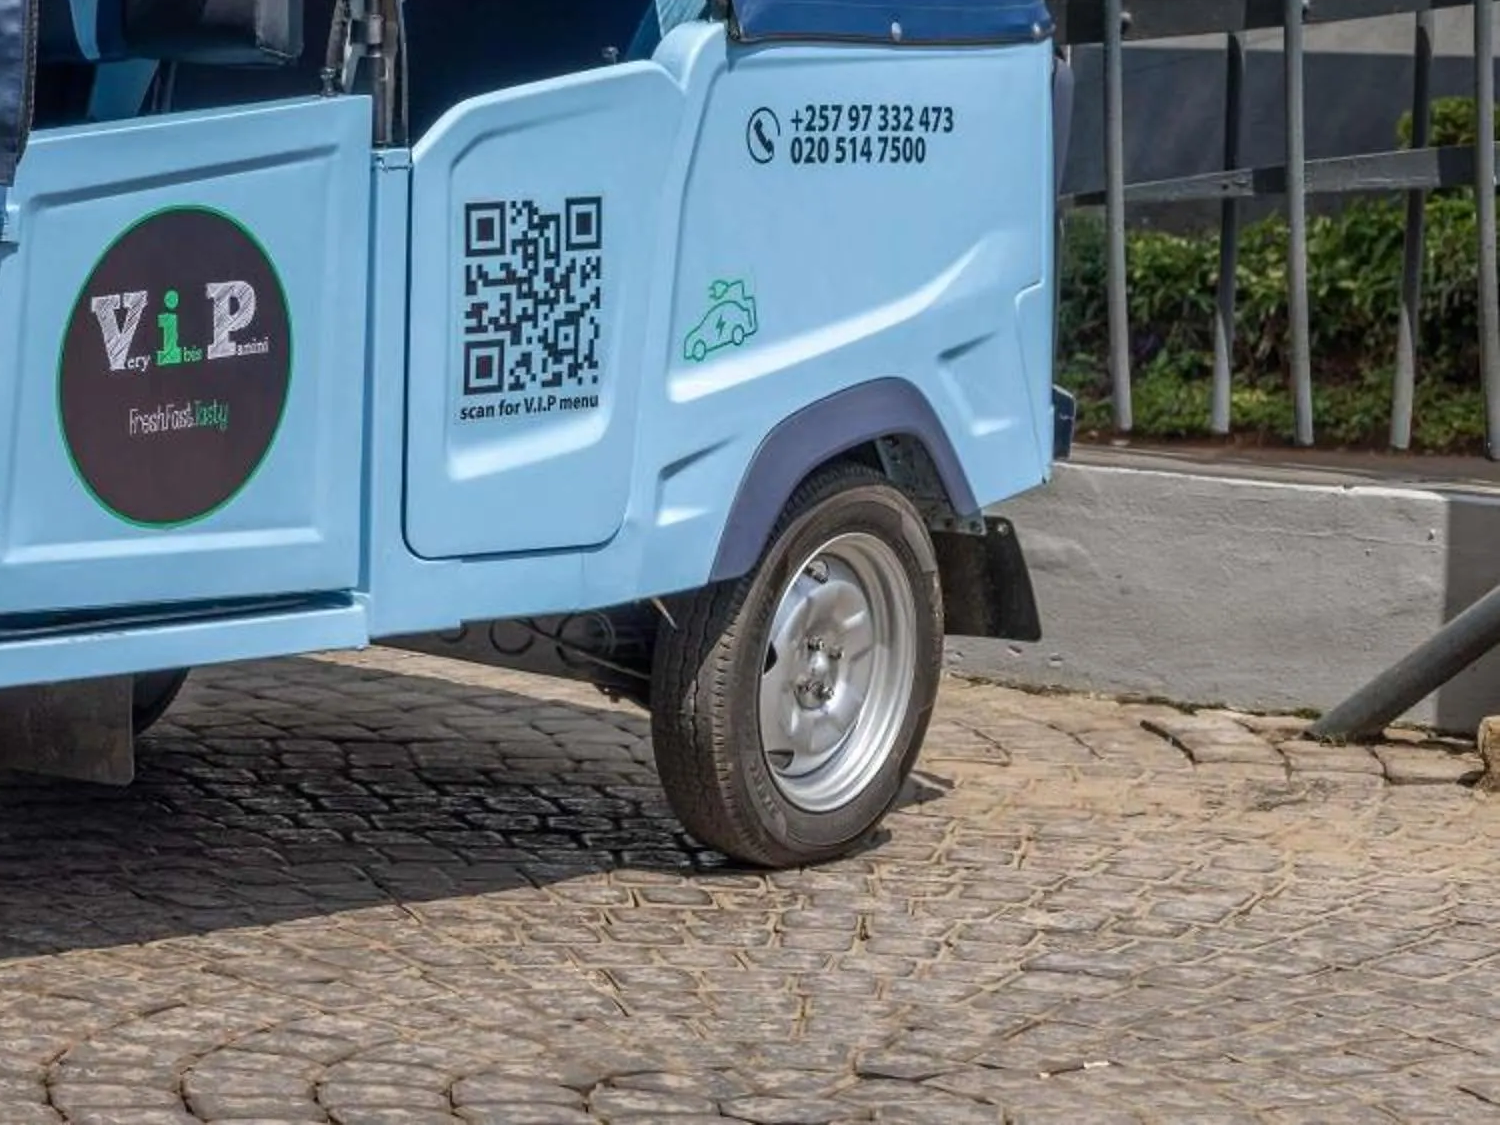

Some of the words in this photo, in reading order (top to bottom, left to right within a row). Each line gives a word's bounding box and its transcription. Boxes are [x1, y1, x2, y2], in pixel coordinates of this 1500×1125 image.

[790, 104, 843, 132] +257
[847, 104, 873, 132] 97
[877, 104, 914, 132] 332
[918, 105, 954, 133] 473
[790, 136, 829, 164] 020
[834, 136, 873, 163] 514
[877, 136, 926, 163] 7500
[459, 404, 495, 421] scan
[498, 398, 521, 417] for
[523, 394, 557, 414] V.I.P
[559, 394, 599, 411] menu
